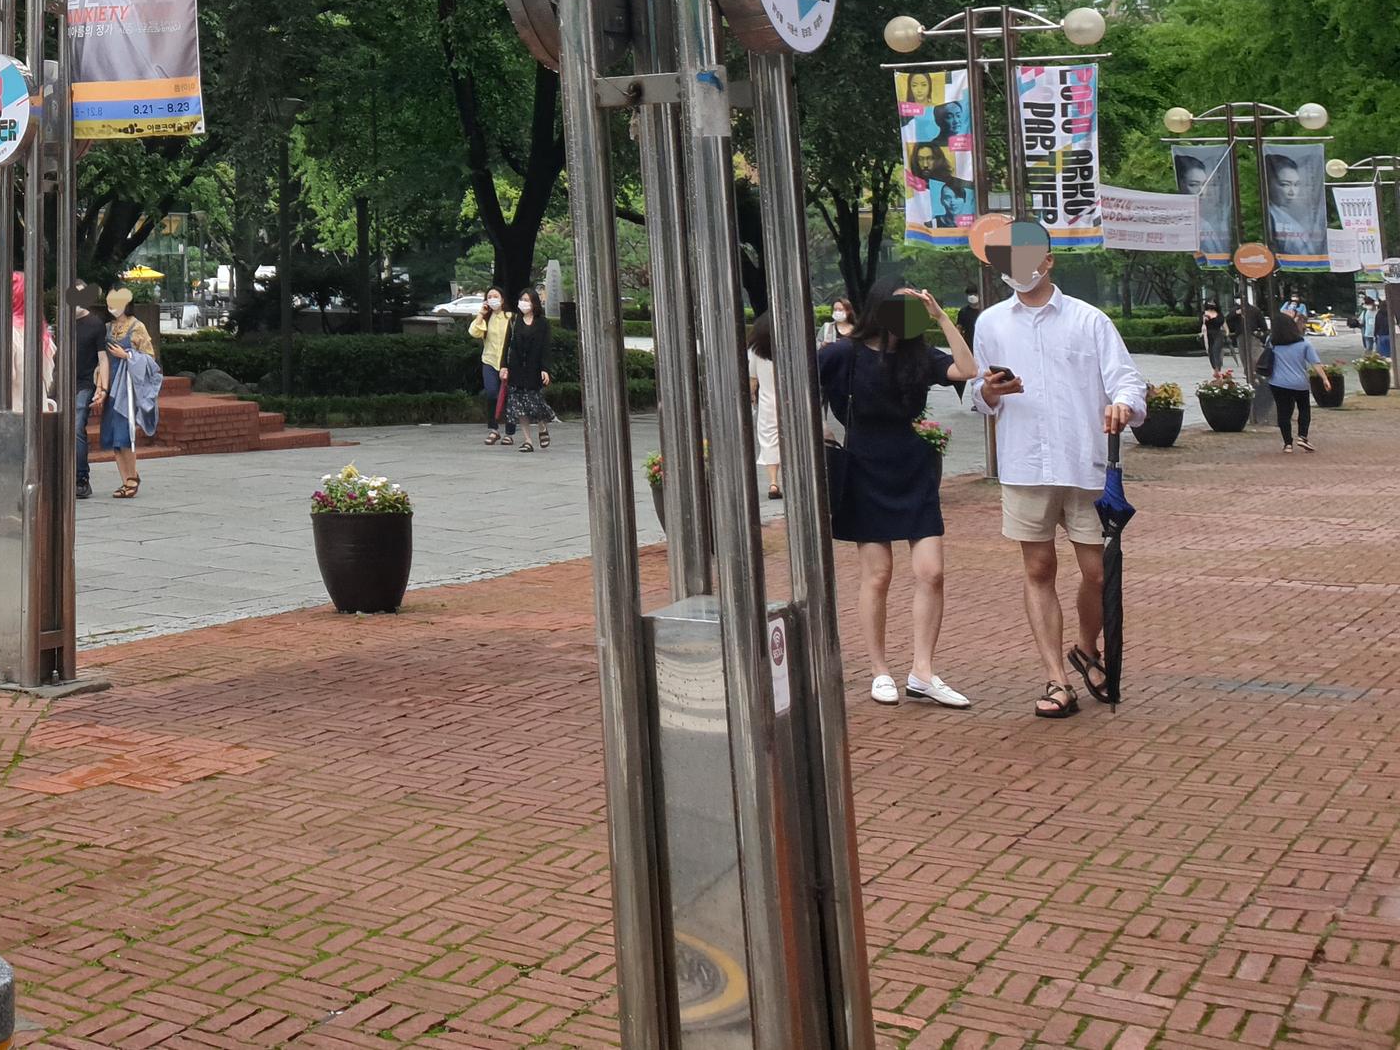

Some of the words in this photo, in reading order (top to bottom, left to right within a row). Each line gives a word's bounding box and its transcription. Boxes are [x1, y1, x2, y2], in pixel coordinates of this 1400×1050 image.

[67, 5, 129, 24] ANXIETY
[133, 104, 153, 115] 8.21
[167, 102, 190, 113] 8.23
[1062, 149, 1097, 216] ARKO
